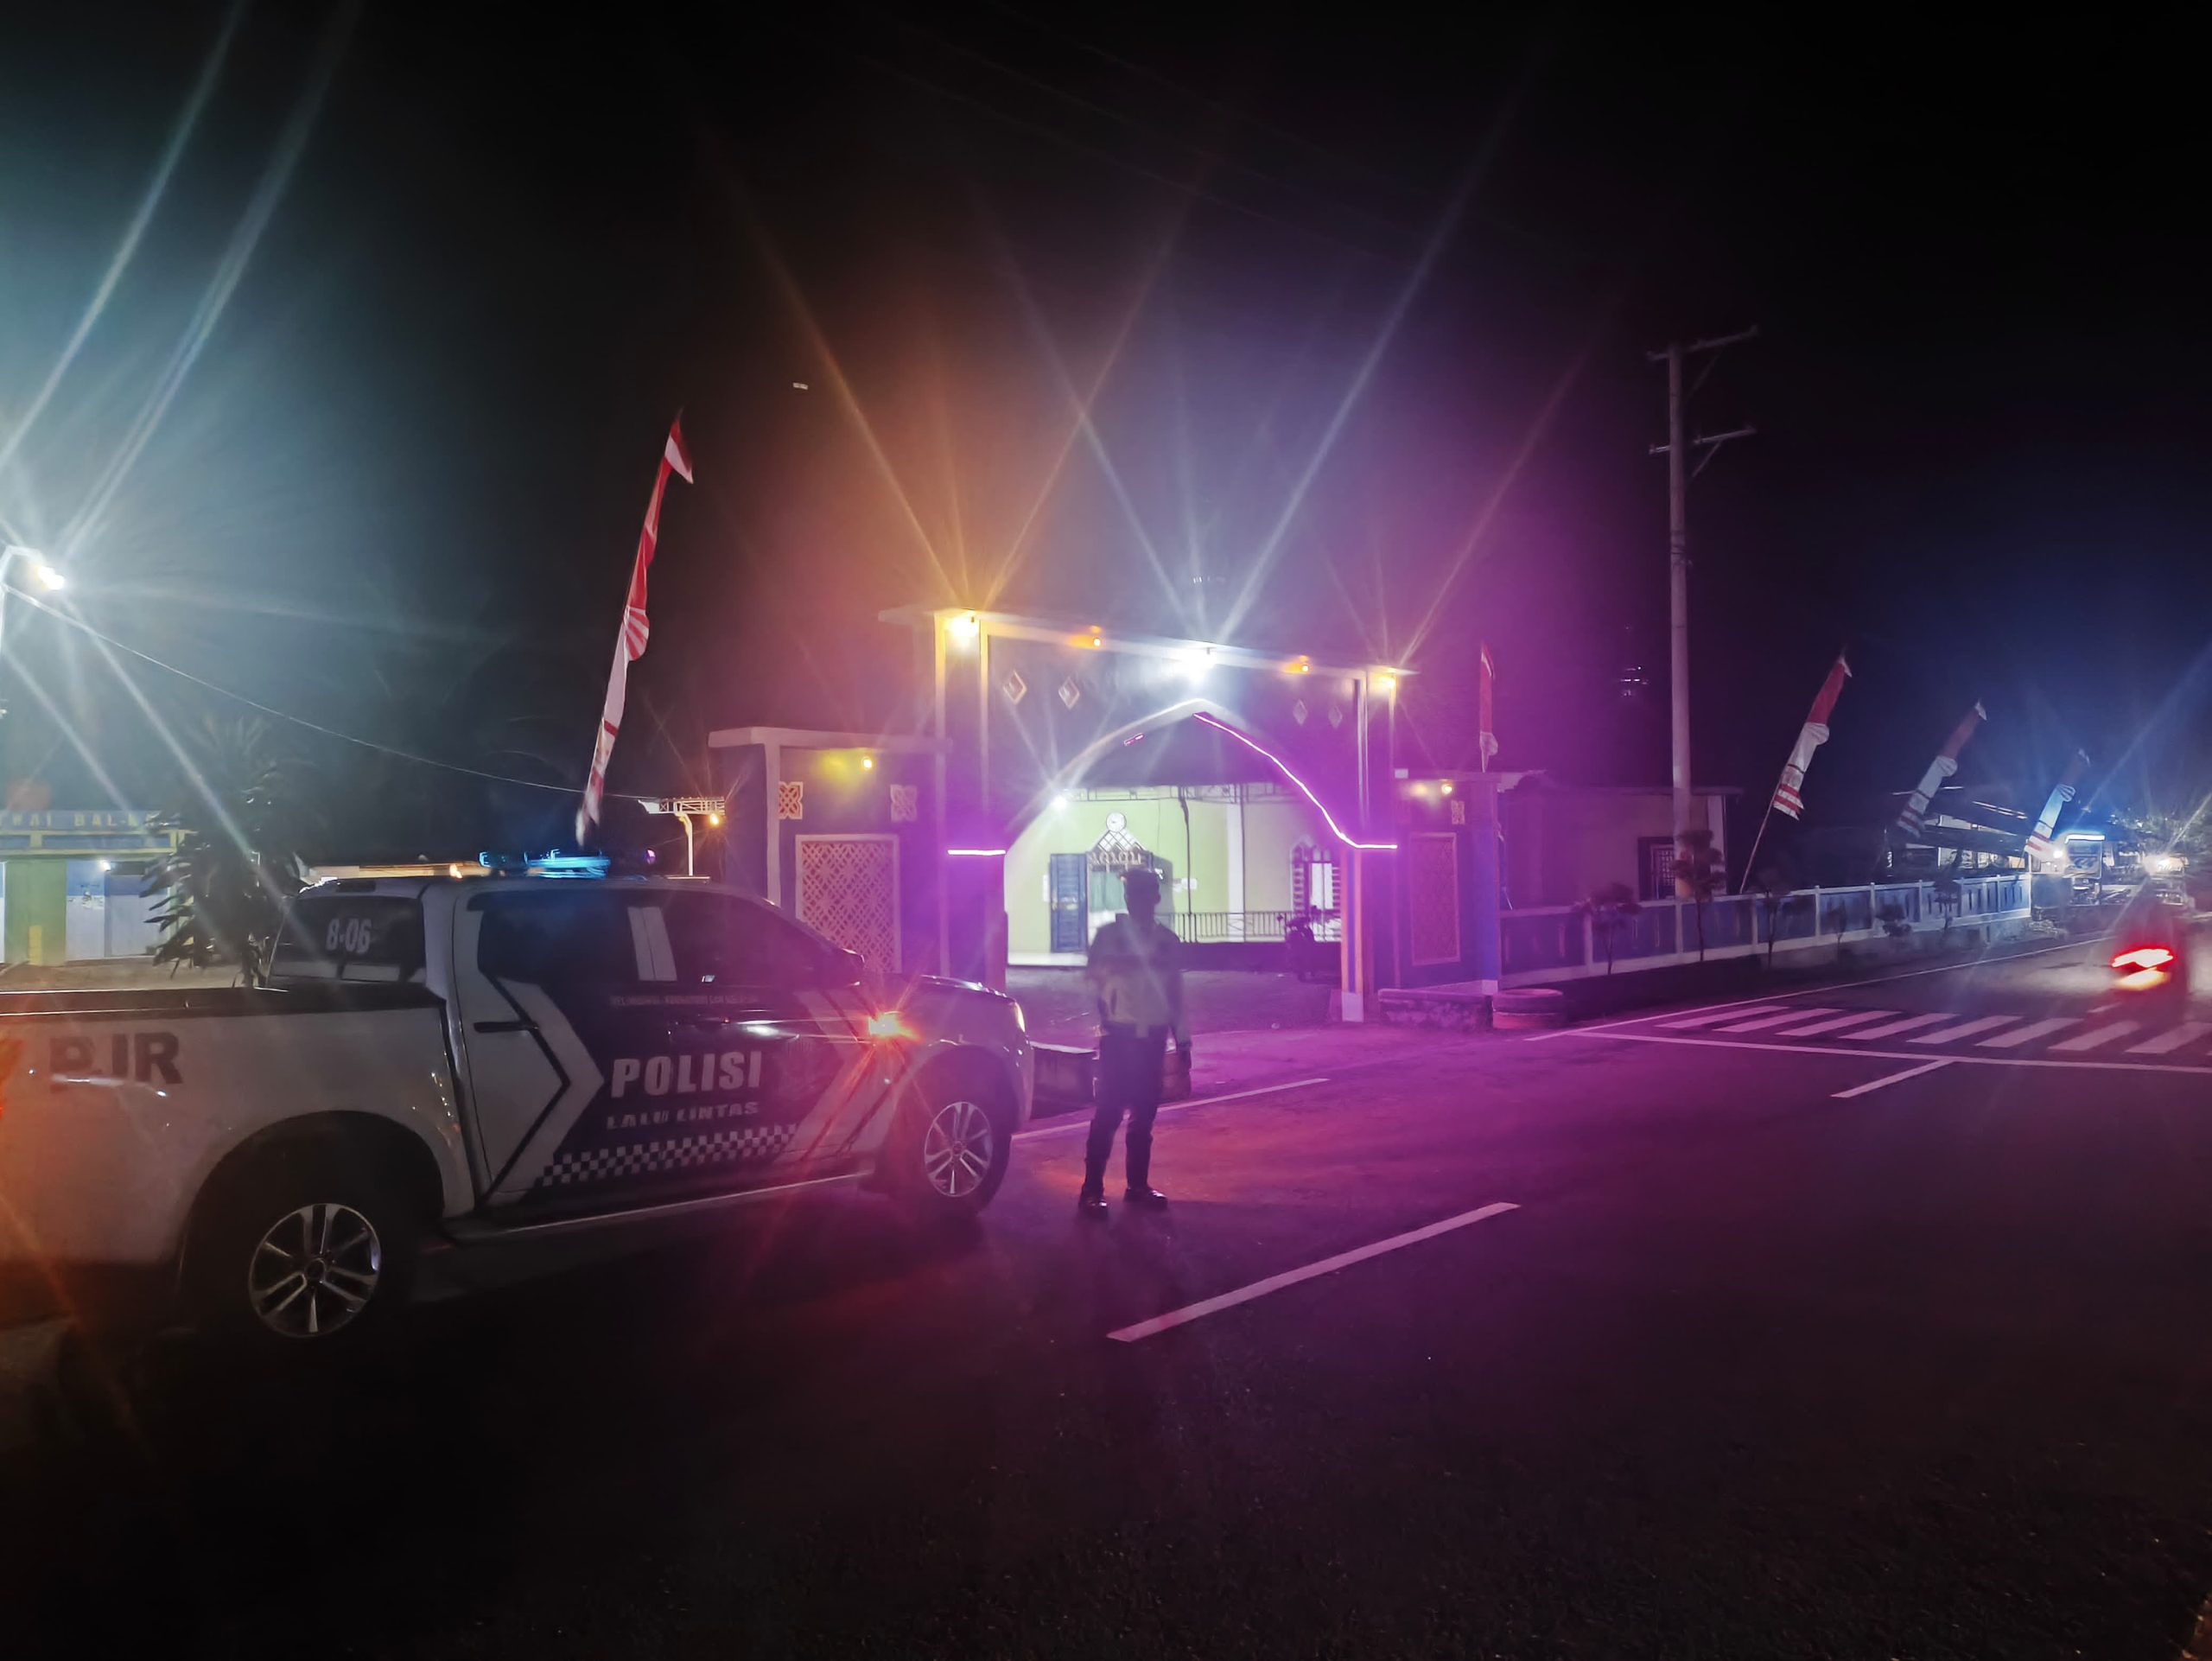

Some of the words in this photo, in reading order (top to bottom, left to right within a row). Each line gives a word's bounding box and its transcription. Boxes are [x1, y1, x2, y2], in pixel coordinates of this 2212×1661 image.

[326, 918, 372, 954] 8-06
[611, 1051, 762, 1098] POLISI
[607, 1111, 671, 1130] LALU
[677, 1101, 759, 1123] LINTAS
